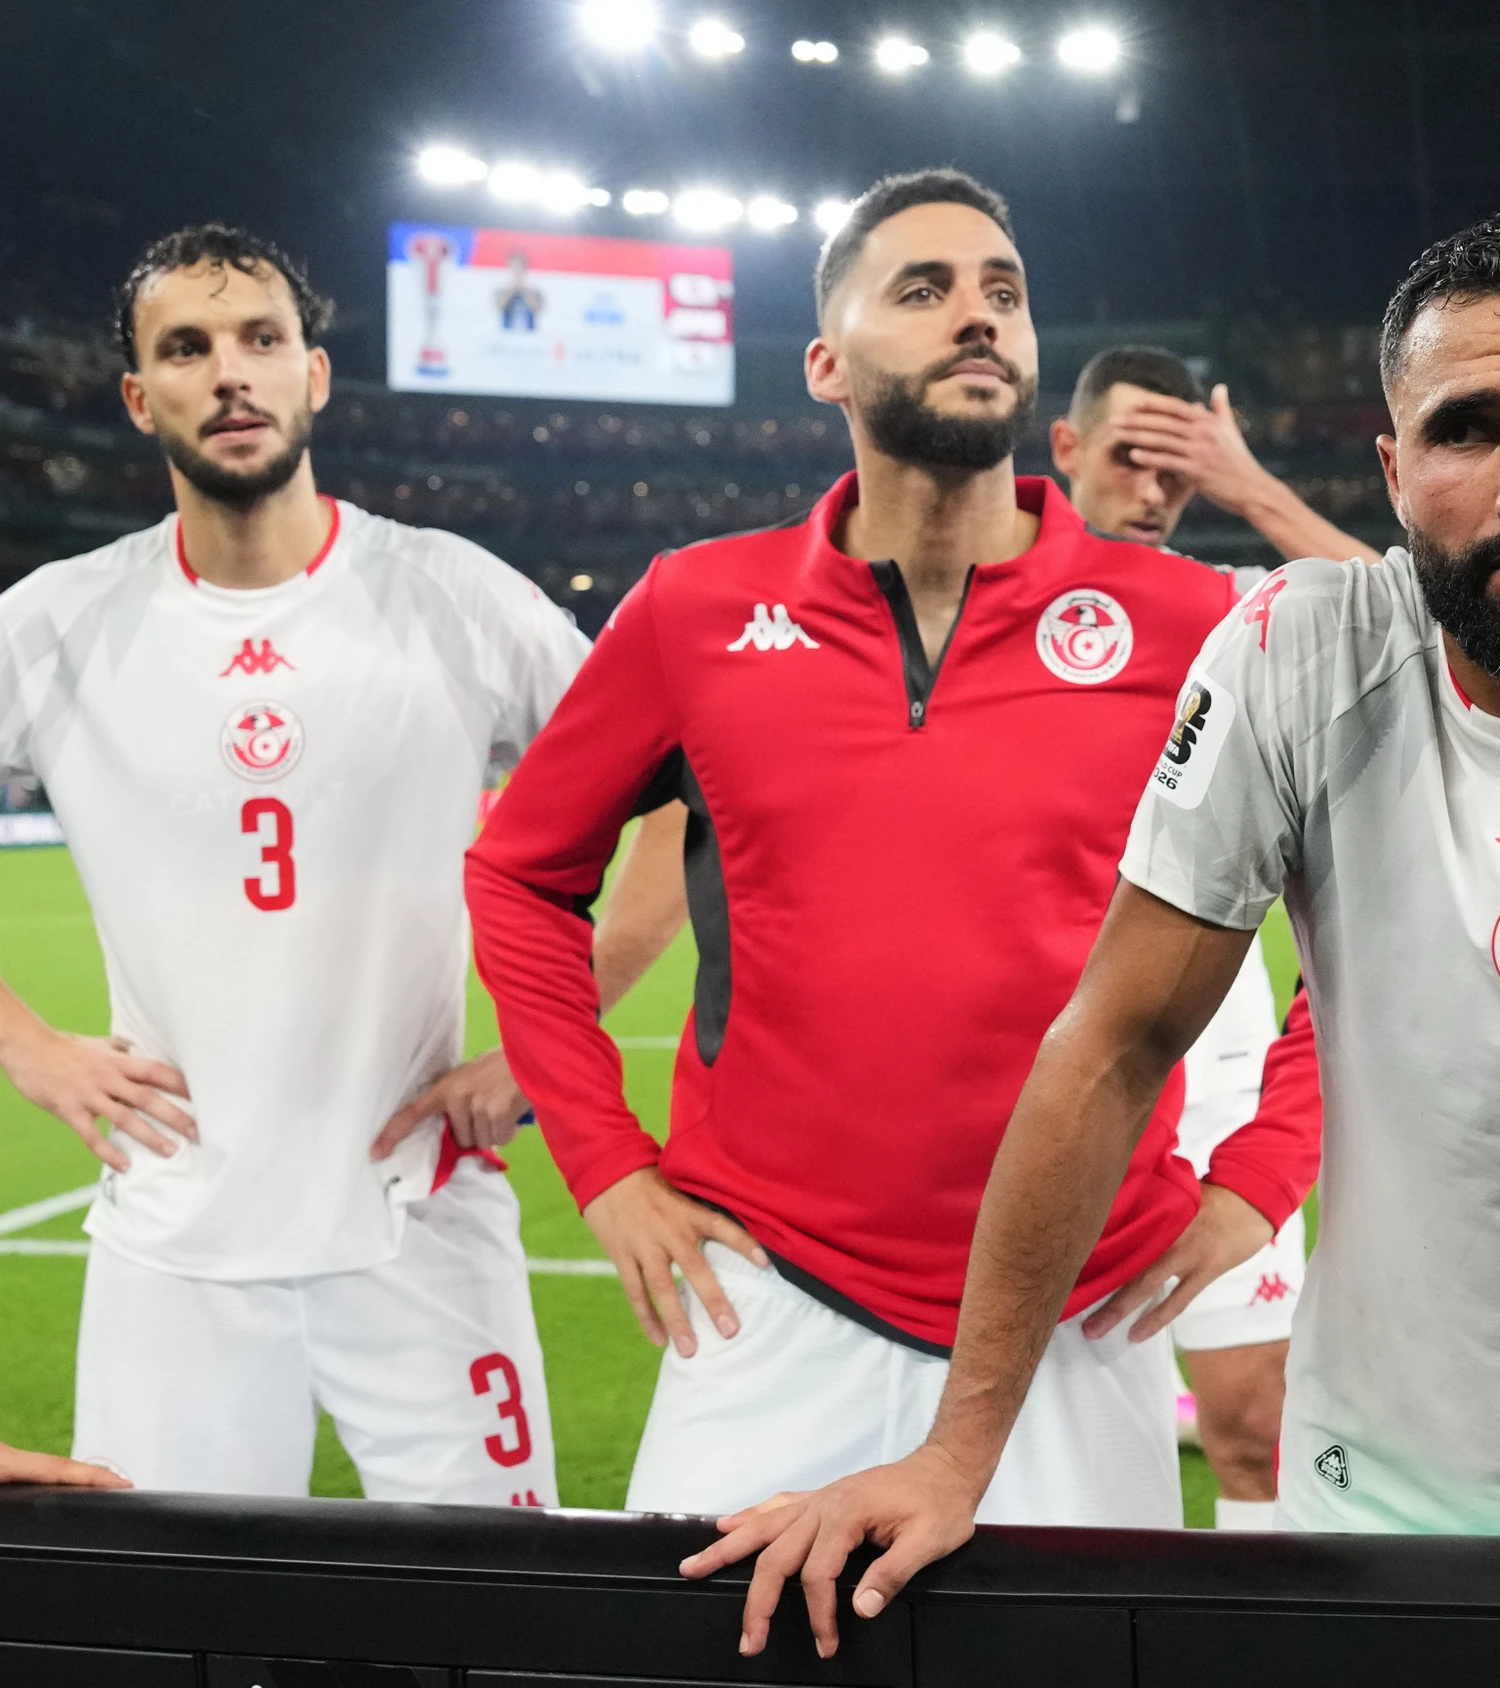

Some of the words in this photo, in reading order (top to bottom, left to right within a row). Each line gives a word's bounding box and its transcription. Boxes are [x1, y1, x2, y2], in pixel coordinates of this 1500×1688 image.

[1166, 740, 1180, 757] IFA
[1168, 766, 1183, 777] CUP
[241, 797, 296, 911] 3
[469, 1352, 532, 1468] 3
